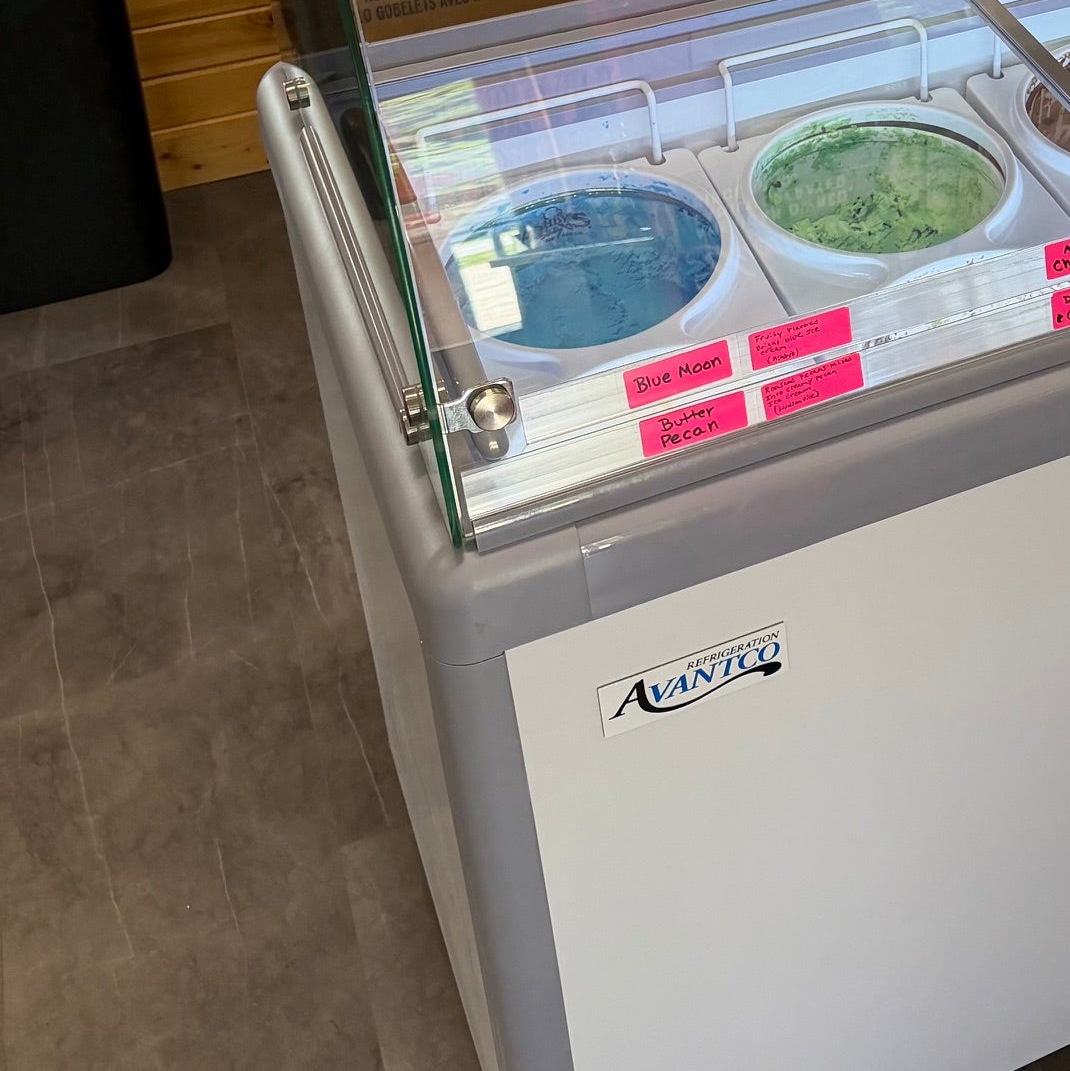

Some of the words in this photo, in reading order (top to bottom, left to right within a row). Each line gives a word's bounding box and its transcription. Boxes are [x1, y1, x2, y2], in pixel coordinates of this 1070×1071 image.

[633, 373, 672, 394] Blue
[678, 355, 723, 378] Moon
[658, 406, 715, 432] Butter
[660, 419, 719, 448] Pecan
[686, 631, 780, 670] REFRIGERATION
[609, 641, 782, 720] AVANTCO
